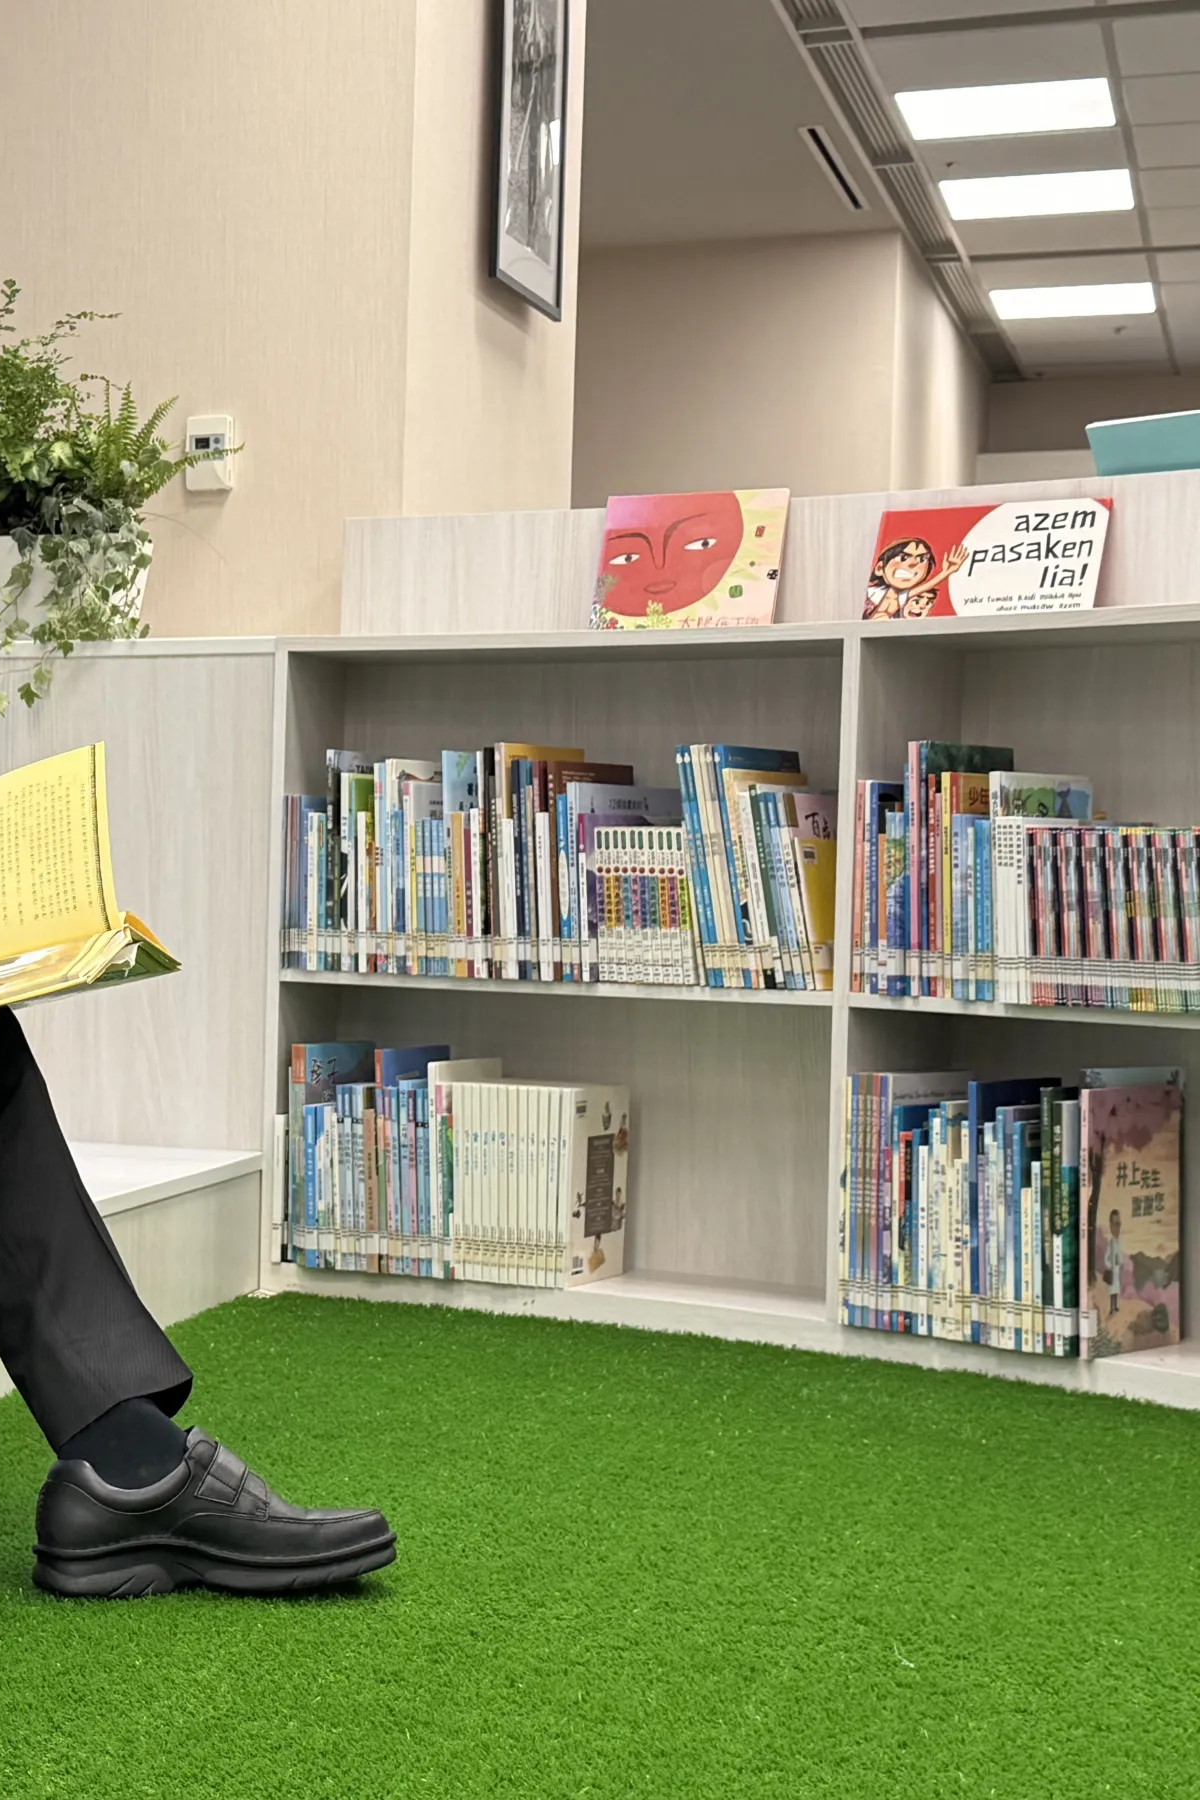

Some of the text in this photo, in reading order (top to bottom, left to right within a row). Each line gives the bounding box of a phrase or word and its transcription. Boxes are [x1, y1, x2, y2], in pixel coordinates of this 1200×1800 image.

[1014, 510, 1097, 533] azem
[967, 532, 1094, 577] pasaken
[1039, 563, 1089, 588] lia!
[1115, 1161, 1161, 1189] 井上先生
